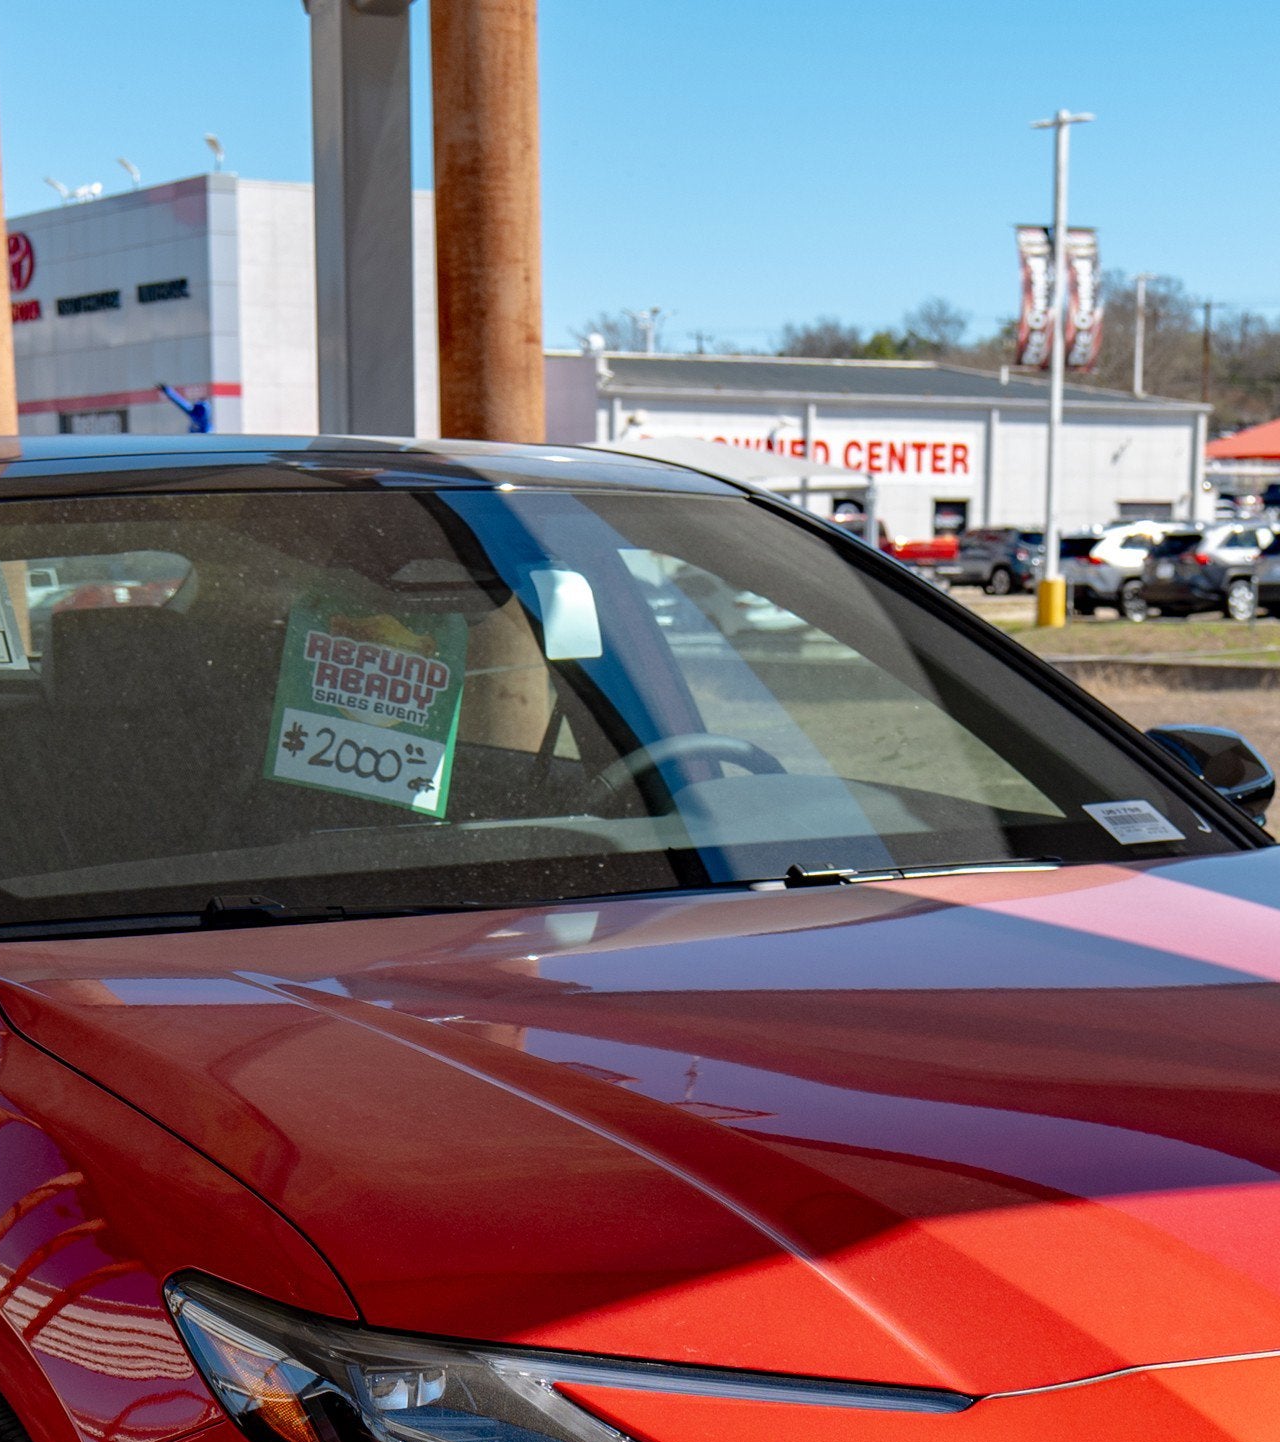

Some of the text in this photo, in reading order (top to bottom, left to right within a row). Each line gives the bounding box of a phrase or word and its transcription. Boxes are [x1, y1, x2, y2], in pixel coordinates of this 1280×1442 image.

[843, 440, 970, 475] CENTER
[306, 632, 448, 689] REFUND
[314, 689, 428, 725] SALES EVENT
[315, 662, 434, 710] READY
